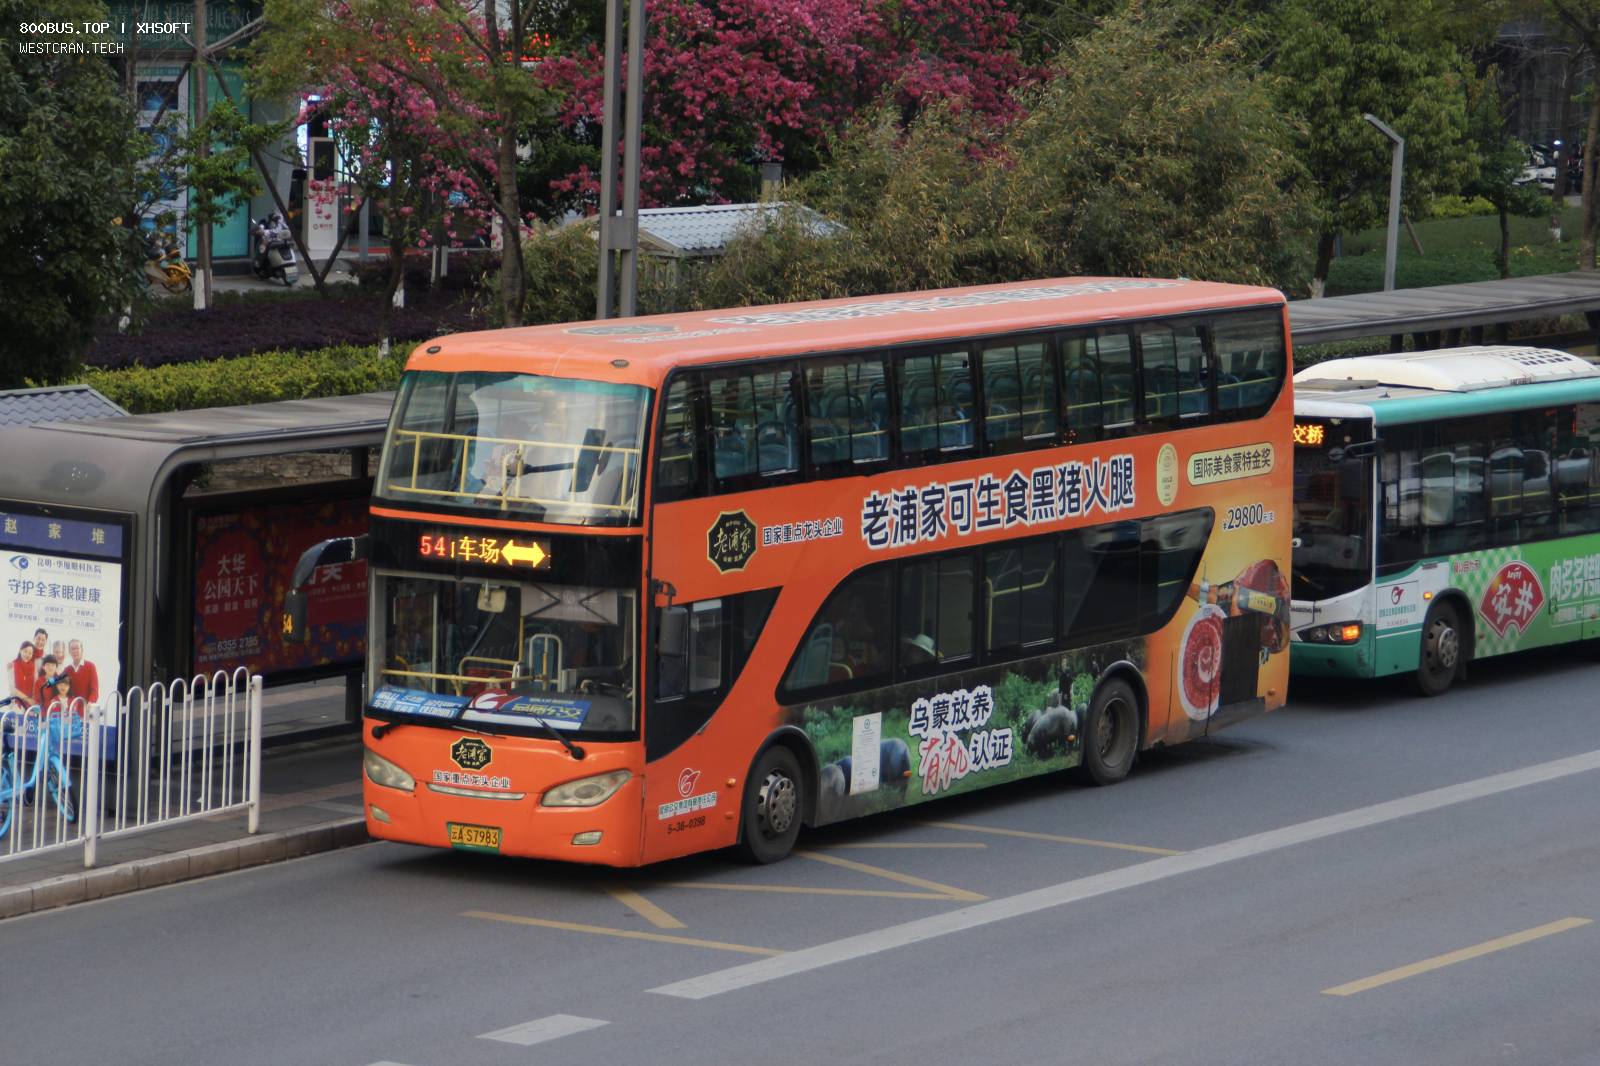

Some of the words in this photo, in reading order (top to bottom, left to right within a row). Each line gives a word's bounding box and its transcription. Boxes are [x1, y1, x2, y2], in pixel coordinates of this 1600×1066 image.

[1193, 447, 1271, 479] 国际美食蒙特金奖
[862, 454, 1135, 550] 老浦家可生食黑猪火腿
[4, 517, 105, 545] 赵家堆
[763, 517, 843, 546] 国家重点龙头企业
[419, 536, 446, 557] 54
[217, 553, 247, 577] 大华
[8, 578, 101, 604] 守护全家眼健康
[203, 574, 259, 601] 公园天下
[911, 691, 990, 732] 乌蒙放养
[922, 733, 1010, 789] 有机认证
[433, 770, 511, 789] 国家重点龙头企业
